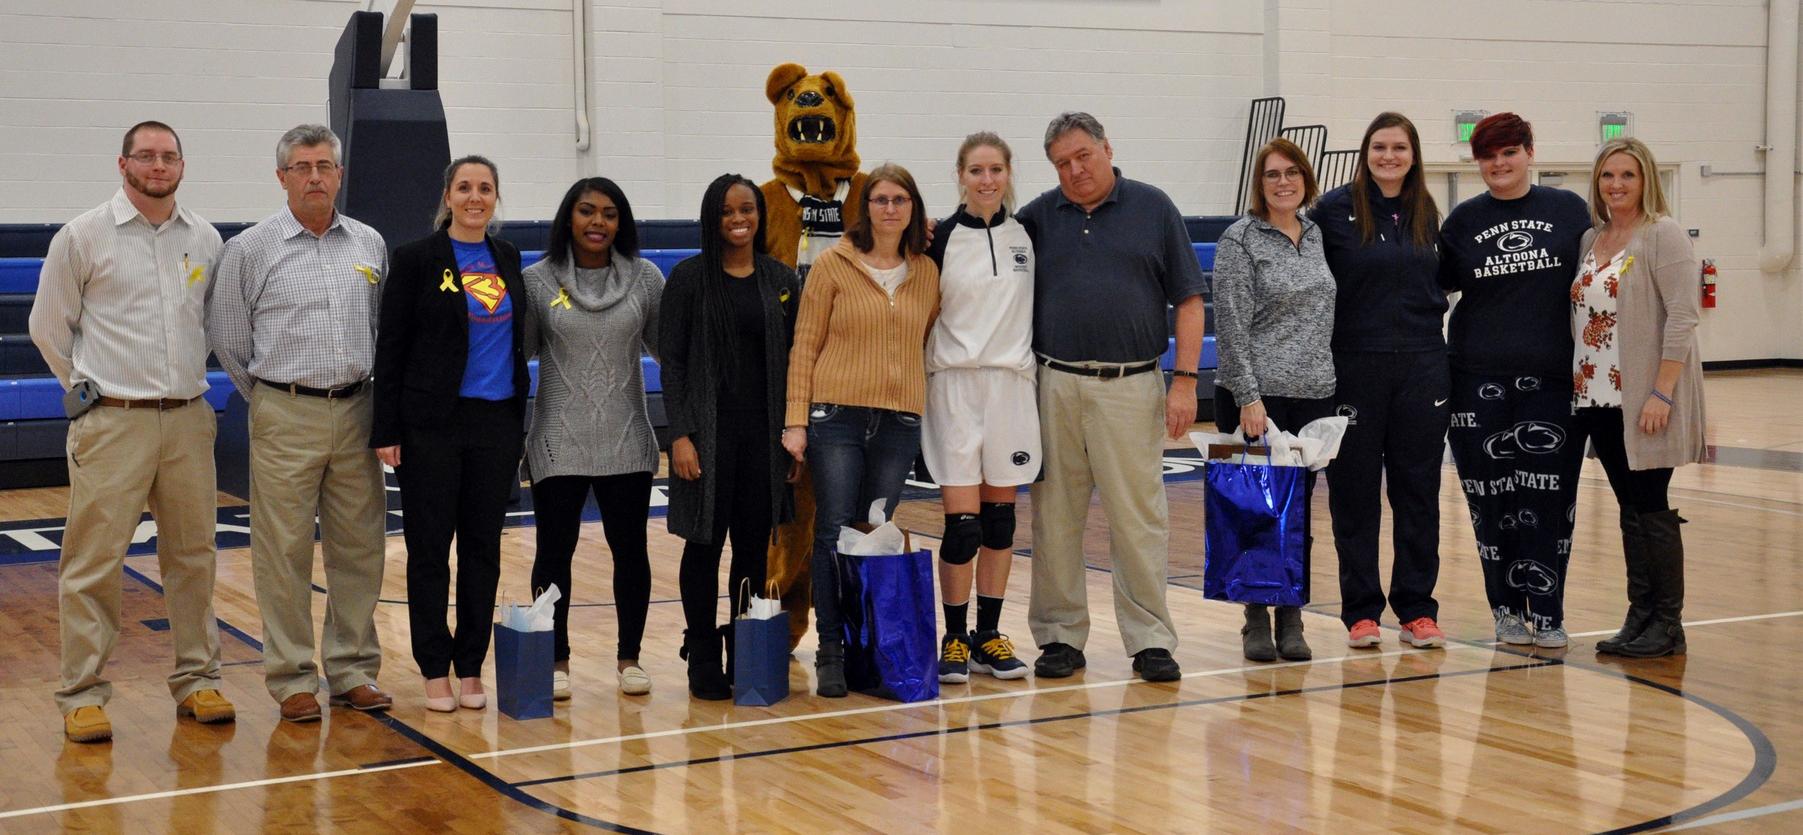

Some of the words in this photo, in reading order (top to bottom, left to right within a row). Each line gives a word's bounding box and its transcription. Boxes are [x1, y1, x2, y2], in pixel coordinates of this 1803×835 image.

[1474, 222, 1509, 244] PENN
[1511, 219, 1554, 233] STATE
[1473, 256, 1562, 279] BASKETBALL
[1485, 248, 1549, 266] ALTOONA
